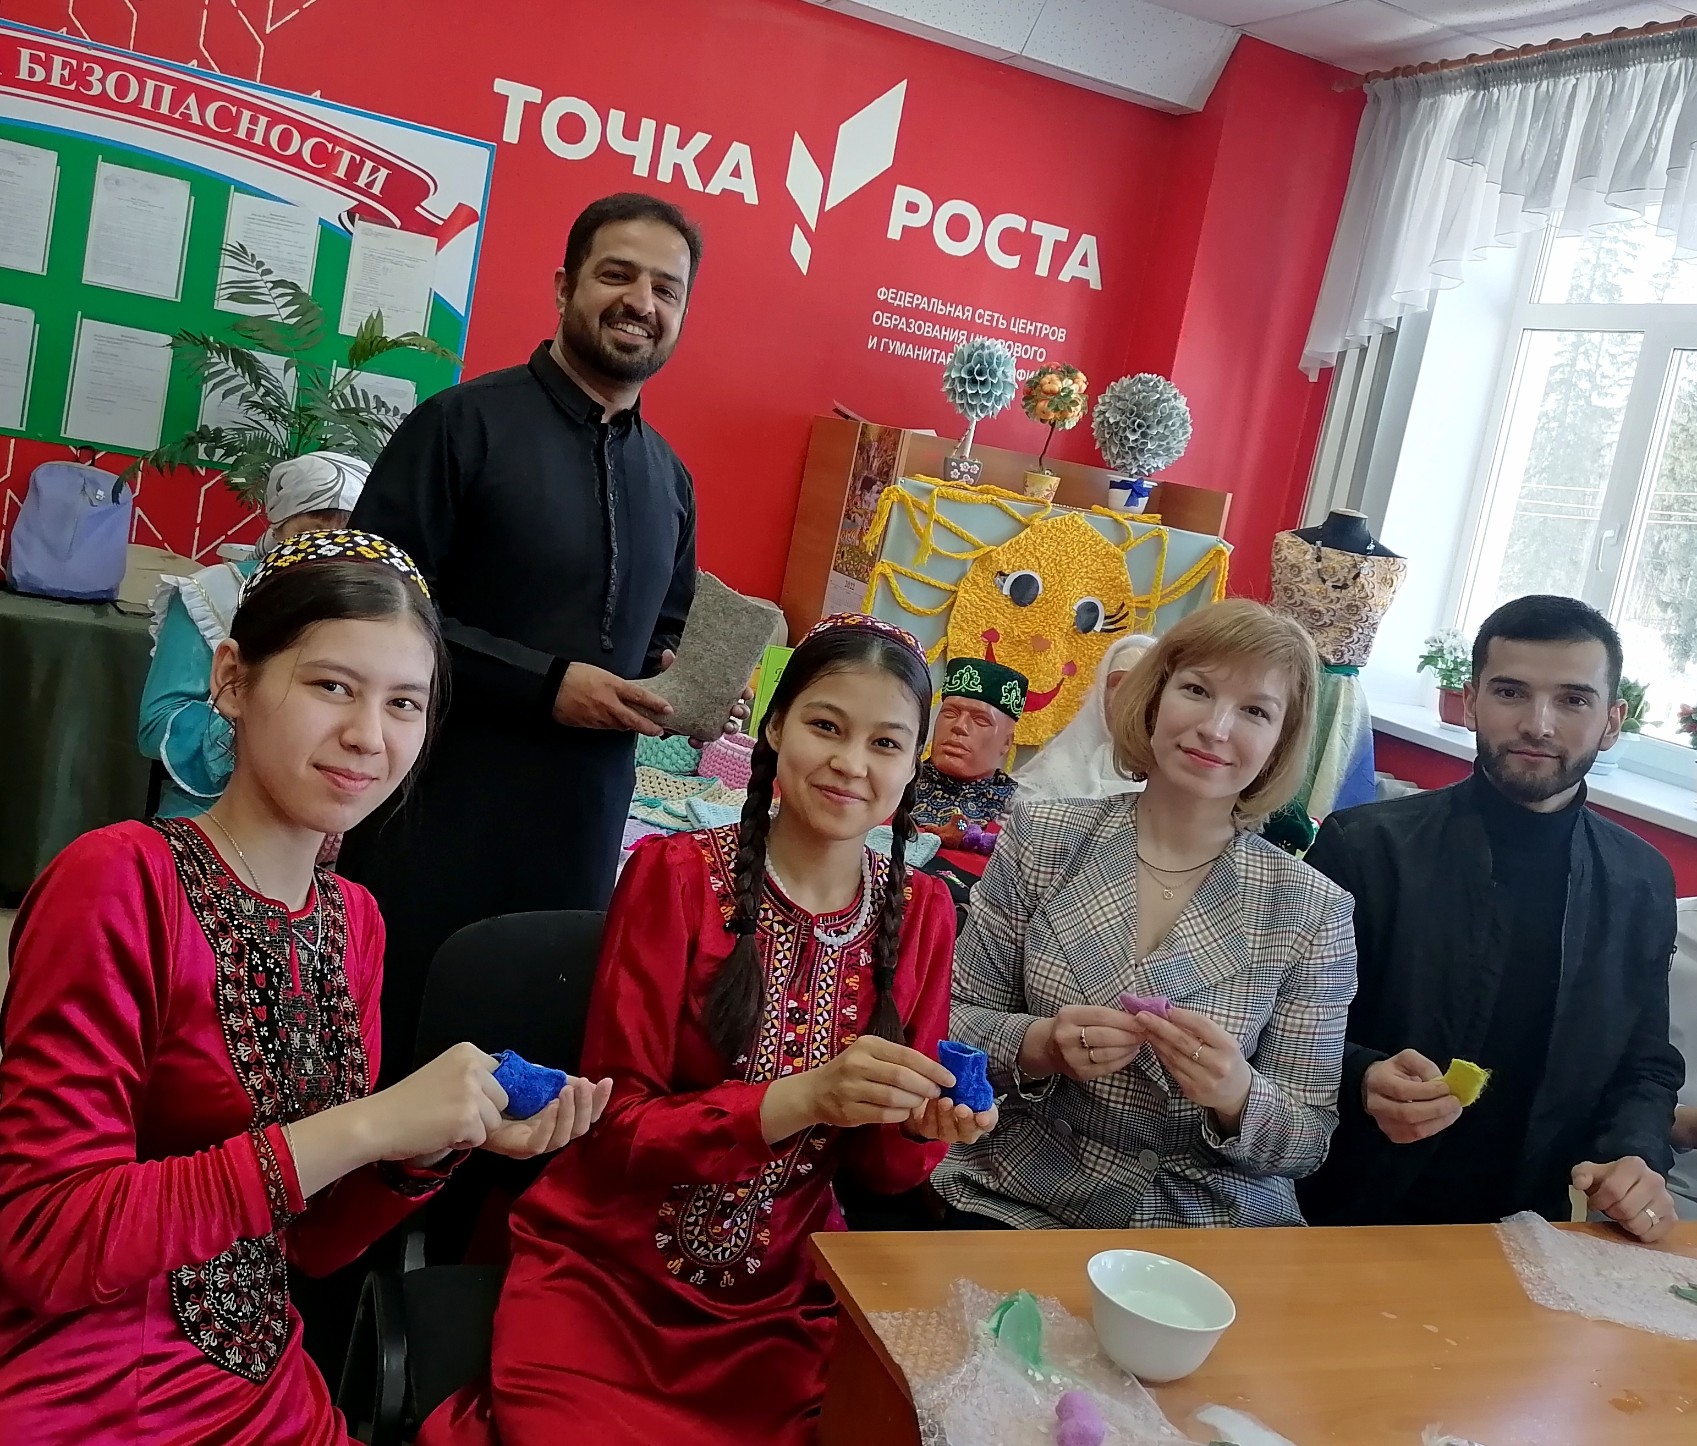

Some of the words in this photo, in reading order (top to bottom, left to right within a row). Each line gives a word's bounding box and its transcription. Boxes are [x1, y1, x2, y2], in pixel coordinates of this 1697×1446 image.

[15, 46, 392, 197] БЕЗОПАСНОСТИ
[493, 77, 759, 206] ТОЧКА
[886, 184, 1102, 291] РОСТА
[872, 310, 967, 345] ОБРАЗОВАНИЯ
[969, 332, 1047, 363] РОВОГО
[876, 286, 973, 321] ФЕДЕРАЛЬНАЯ
[974, 308, 1008, 328] СЕТЬ
[1009, 316, 1067, 343] ЦЕНТРОВ
[867, 335, 878, 350] И
[879, 337, 955, 366] ГУМАНИТАР
